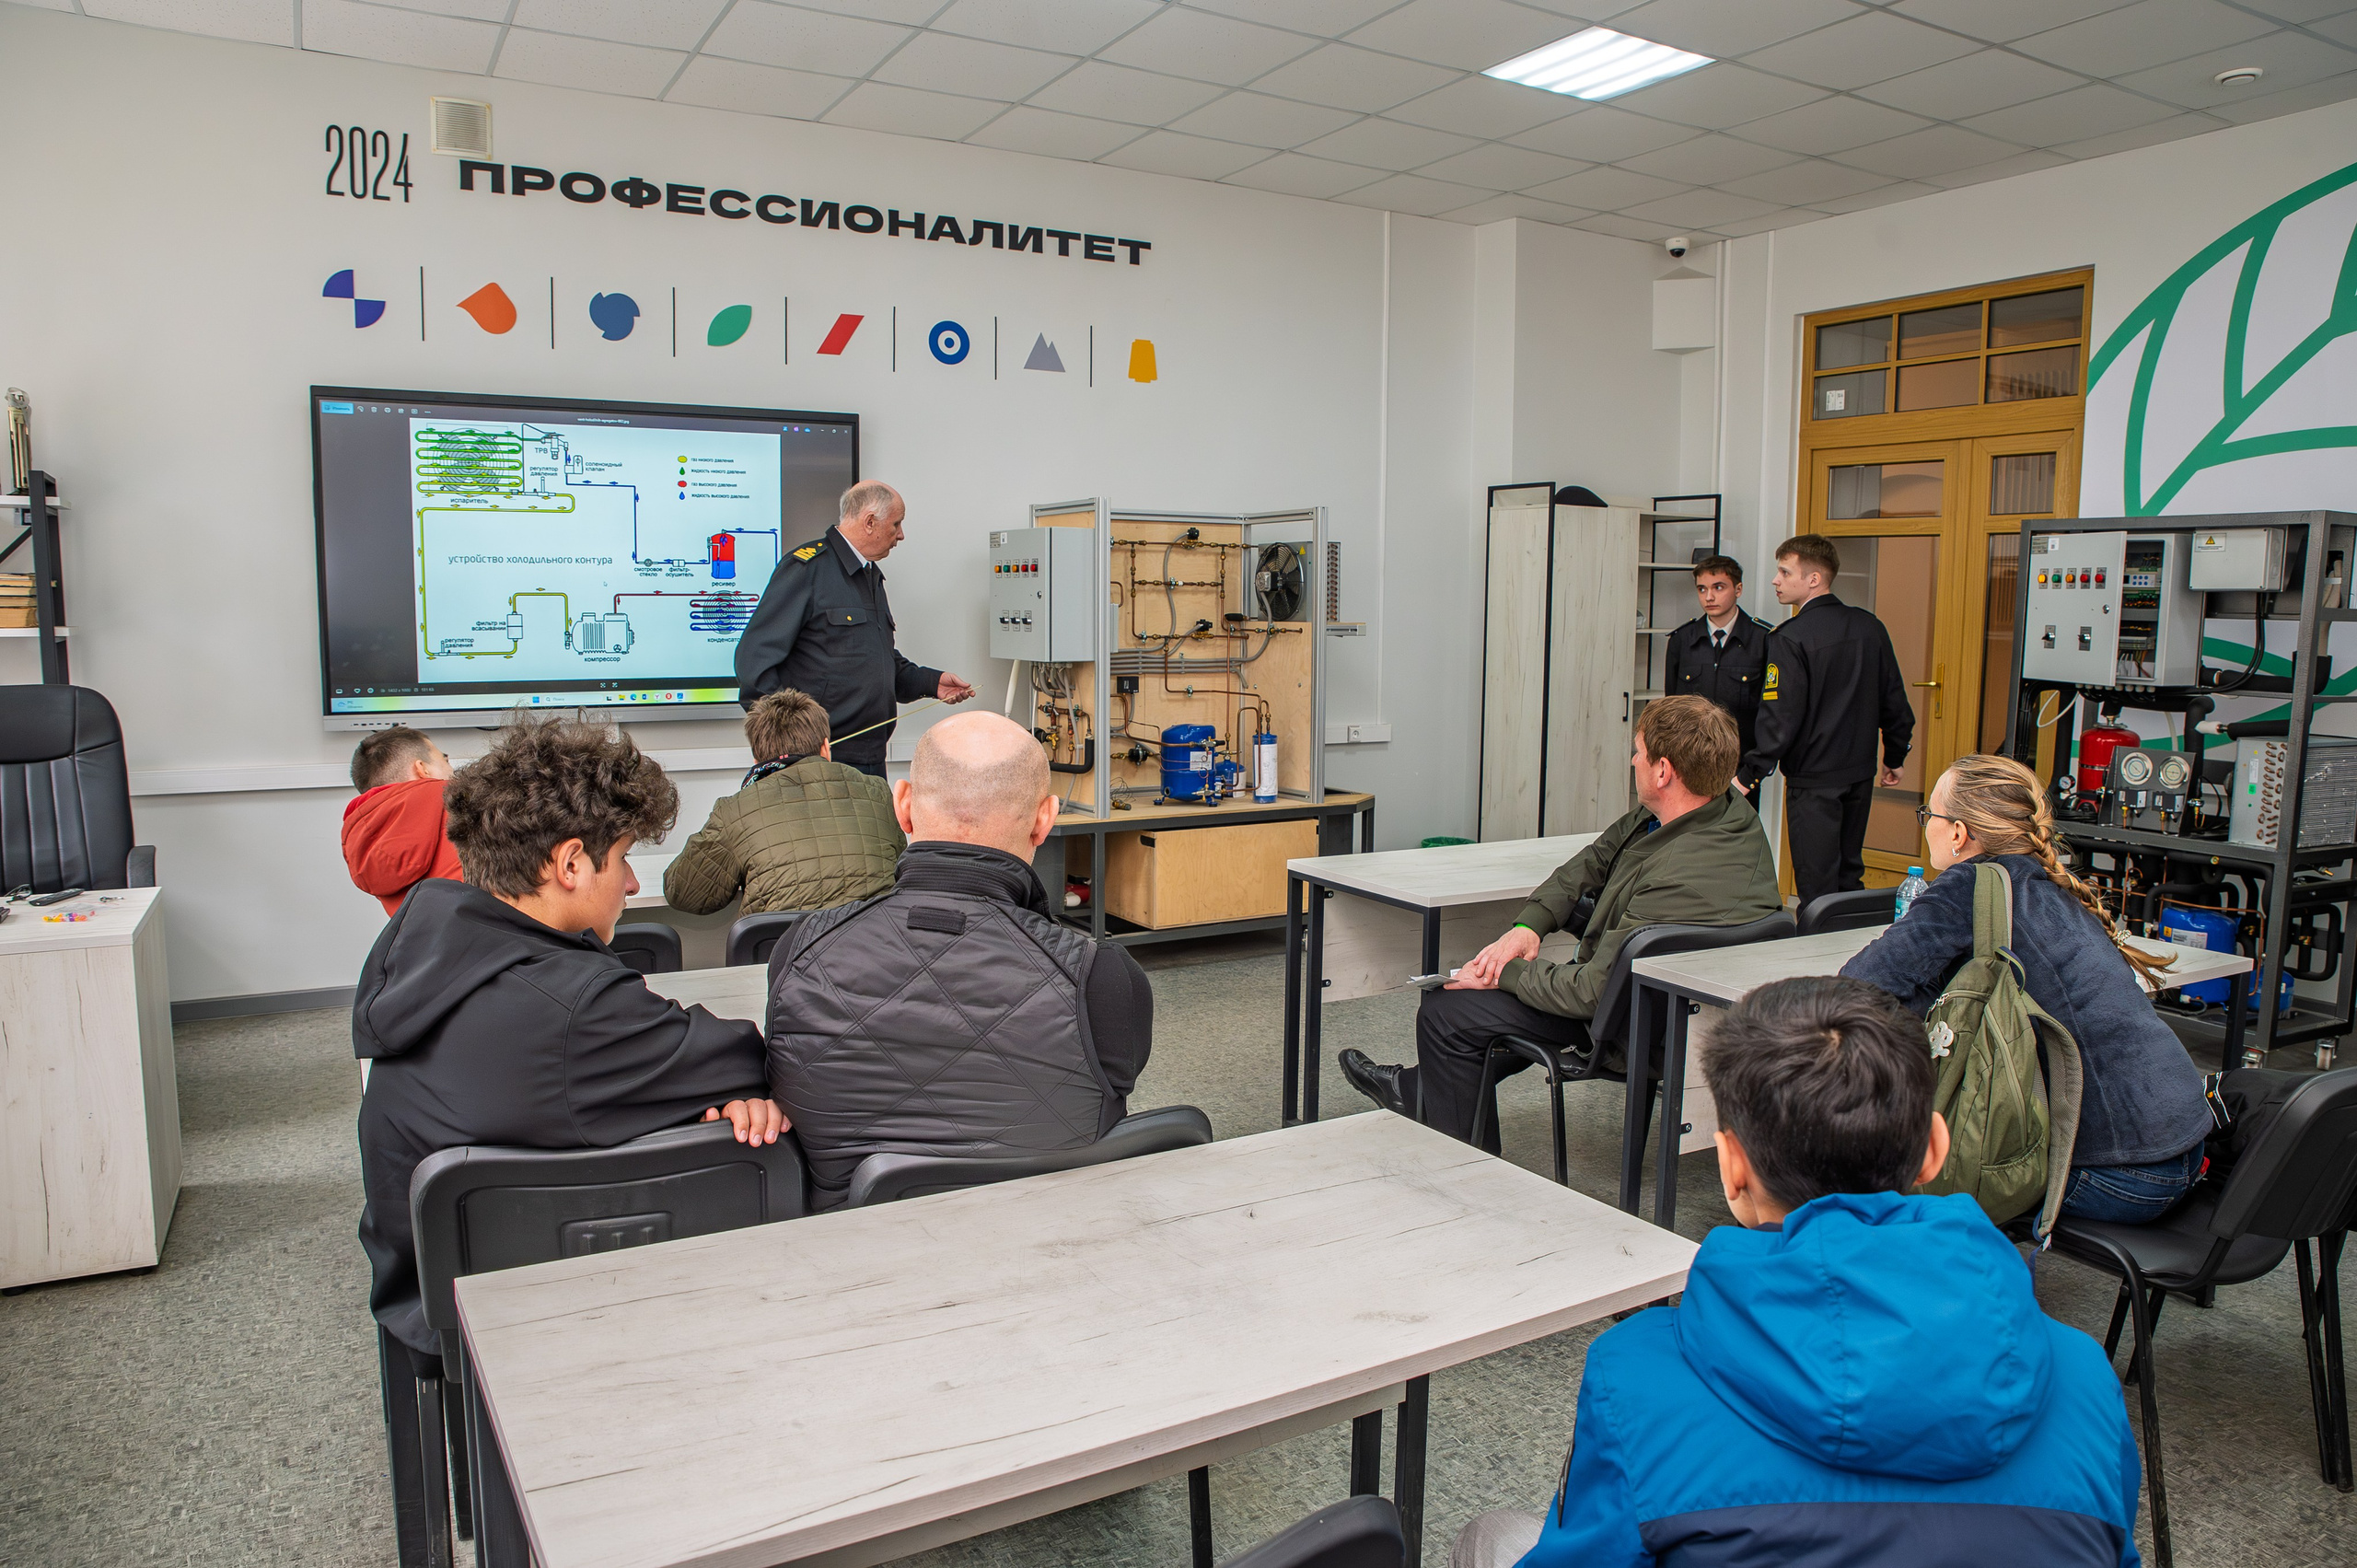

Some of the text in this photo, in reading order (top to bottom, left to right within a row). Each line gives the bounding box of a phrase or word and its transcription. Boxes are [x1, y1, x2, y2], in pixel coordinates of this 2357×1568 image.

[325, 124, 413, 203] 2024
[459, 158, 1153, 267] ПРОФЕССИОНАЛИТЕТ
[447, 554, 613, 565] устройство холодильного контура
